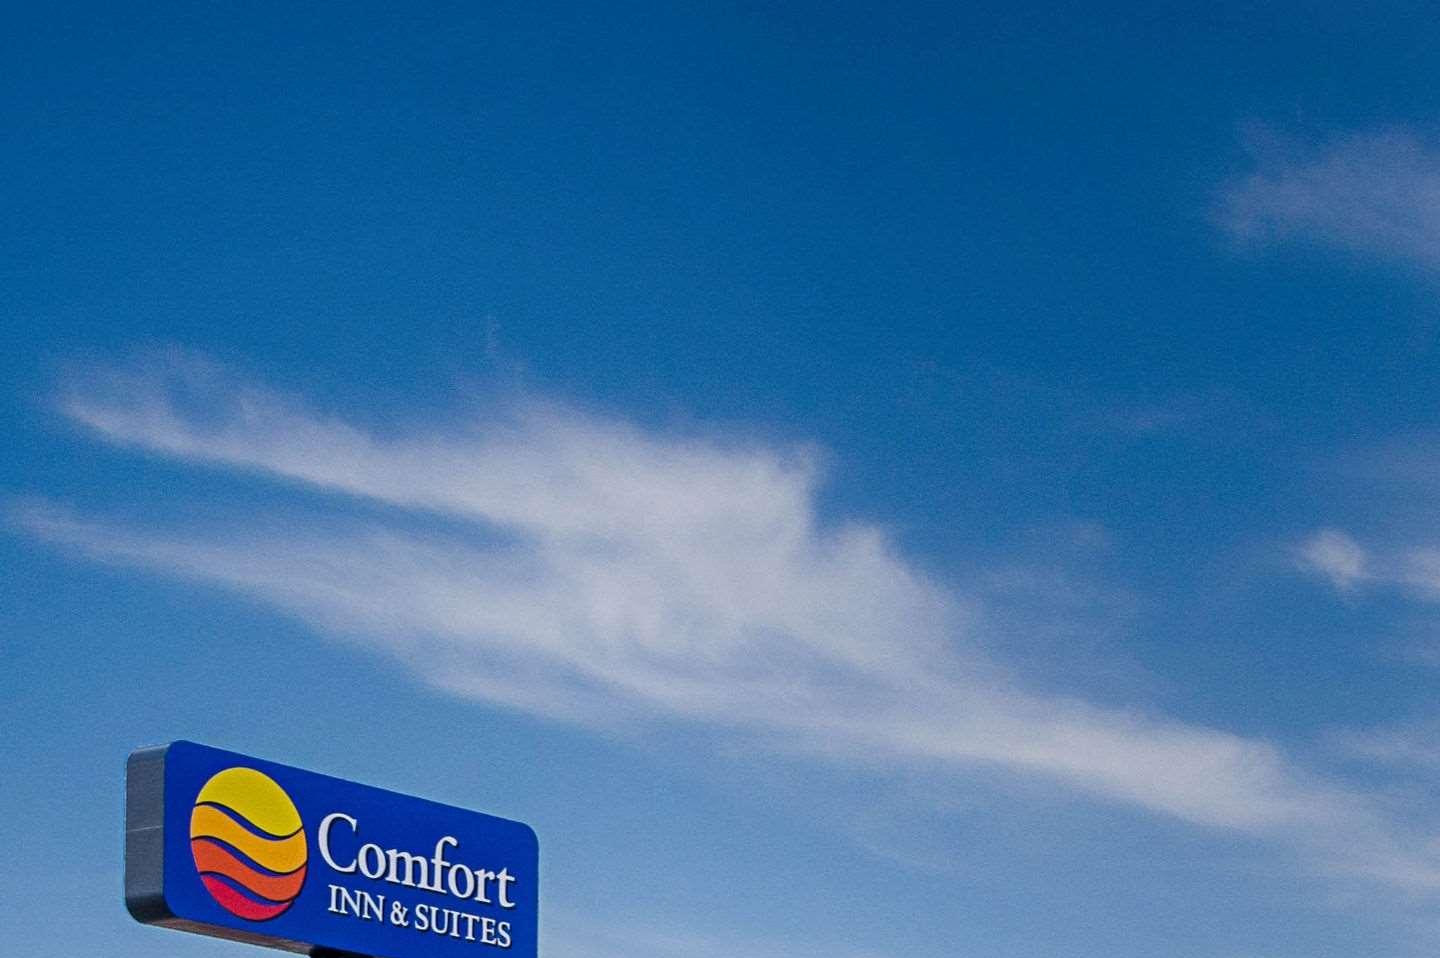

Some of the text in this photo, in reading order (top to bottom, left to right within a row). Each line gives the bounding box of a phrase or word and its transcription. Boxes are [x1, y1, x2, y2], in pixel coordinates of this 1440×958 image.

[318, 812, 516, 908] Comfort
[328, 884, 512, 948] INN & SUITES
